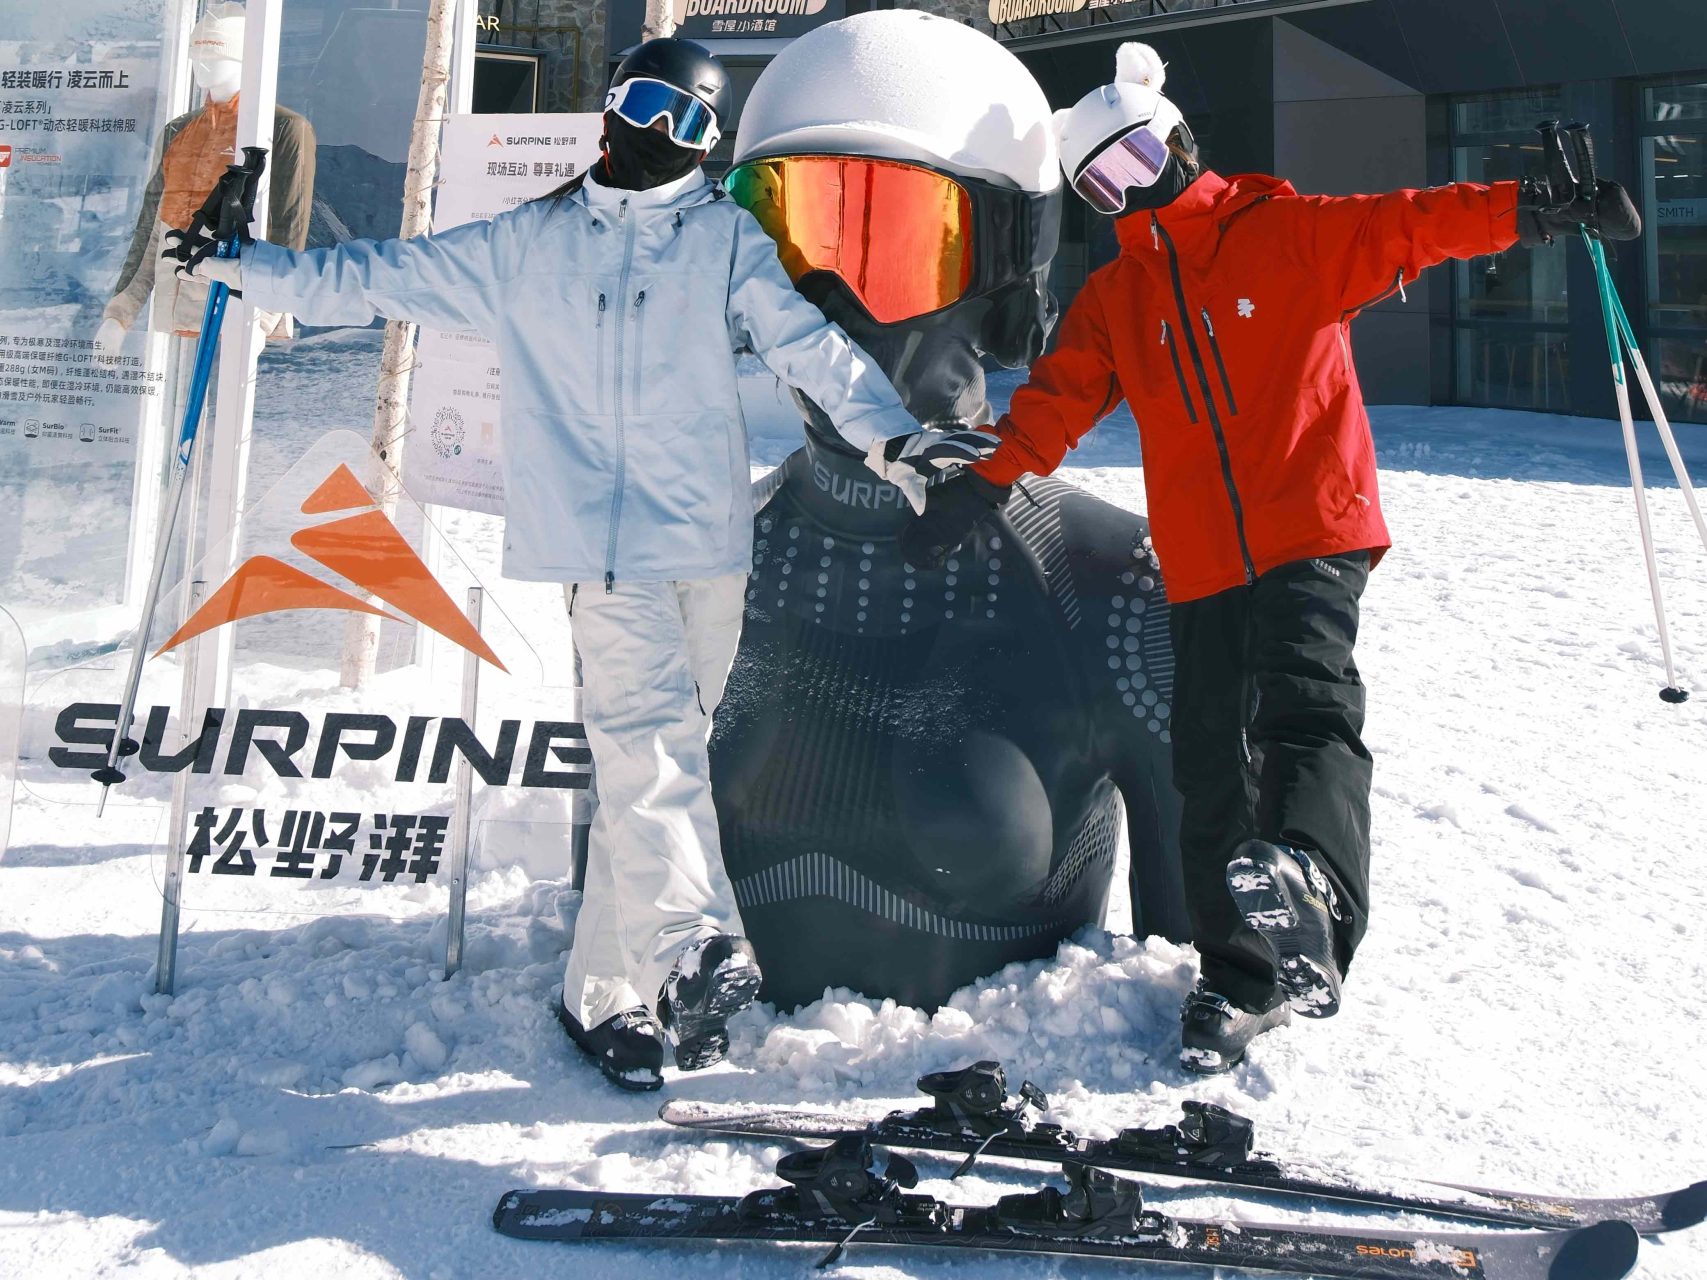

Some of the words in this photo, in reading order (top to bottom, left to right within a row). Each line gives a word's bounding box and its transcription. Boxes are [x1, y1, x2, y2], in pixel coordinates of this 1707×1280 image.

[712, 20, 777, 32] 雪屋小酒馆
[1, 70, 62, 89] 轻装暖行
[67, 70, 129, 89] 凌云而上
[506, 137, 551, 146] SURPINE
[487, 162, 528, 177] 现场互动
[533, 163, 575, 178] 尊享礼遇
[1656, 207, 1694, 218] SMITH
[814, 461, 910, 509] SURPI
[48, 702, 592, 789] SURPINE
[186, 807, 449, 883] 松野湃
